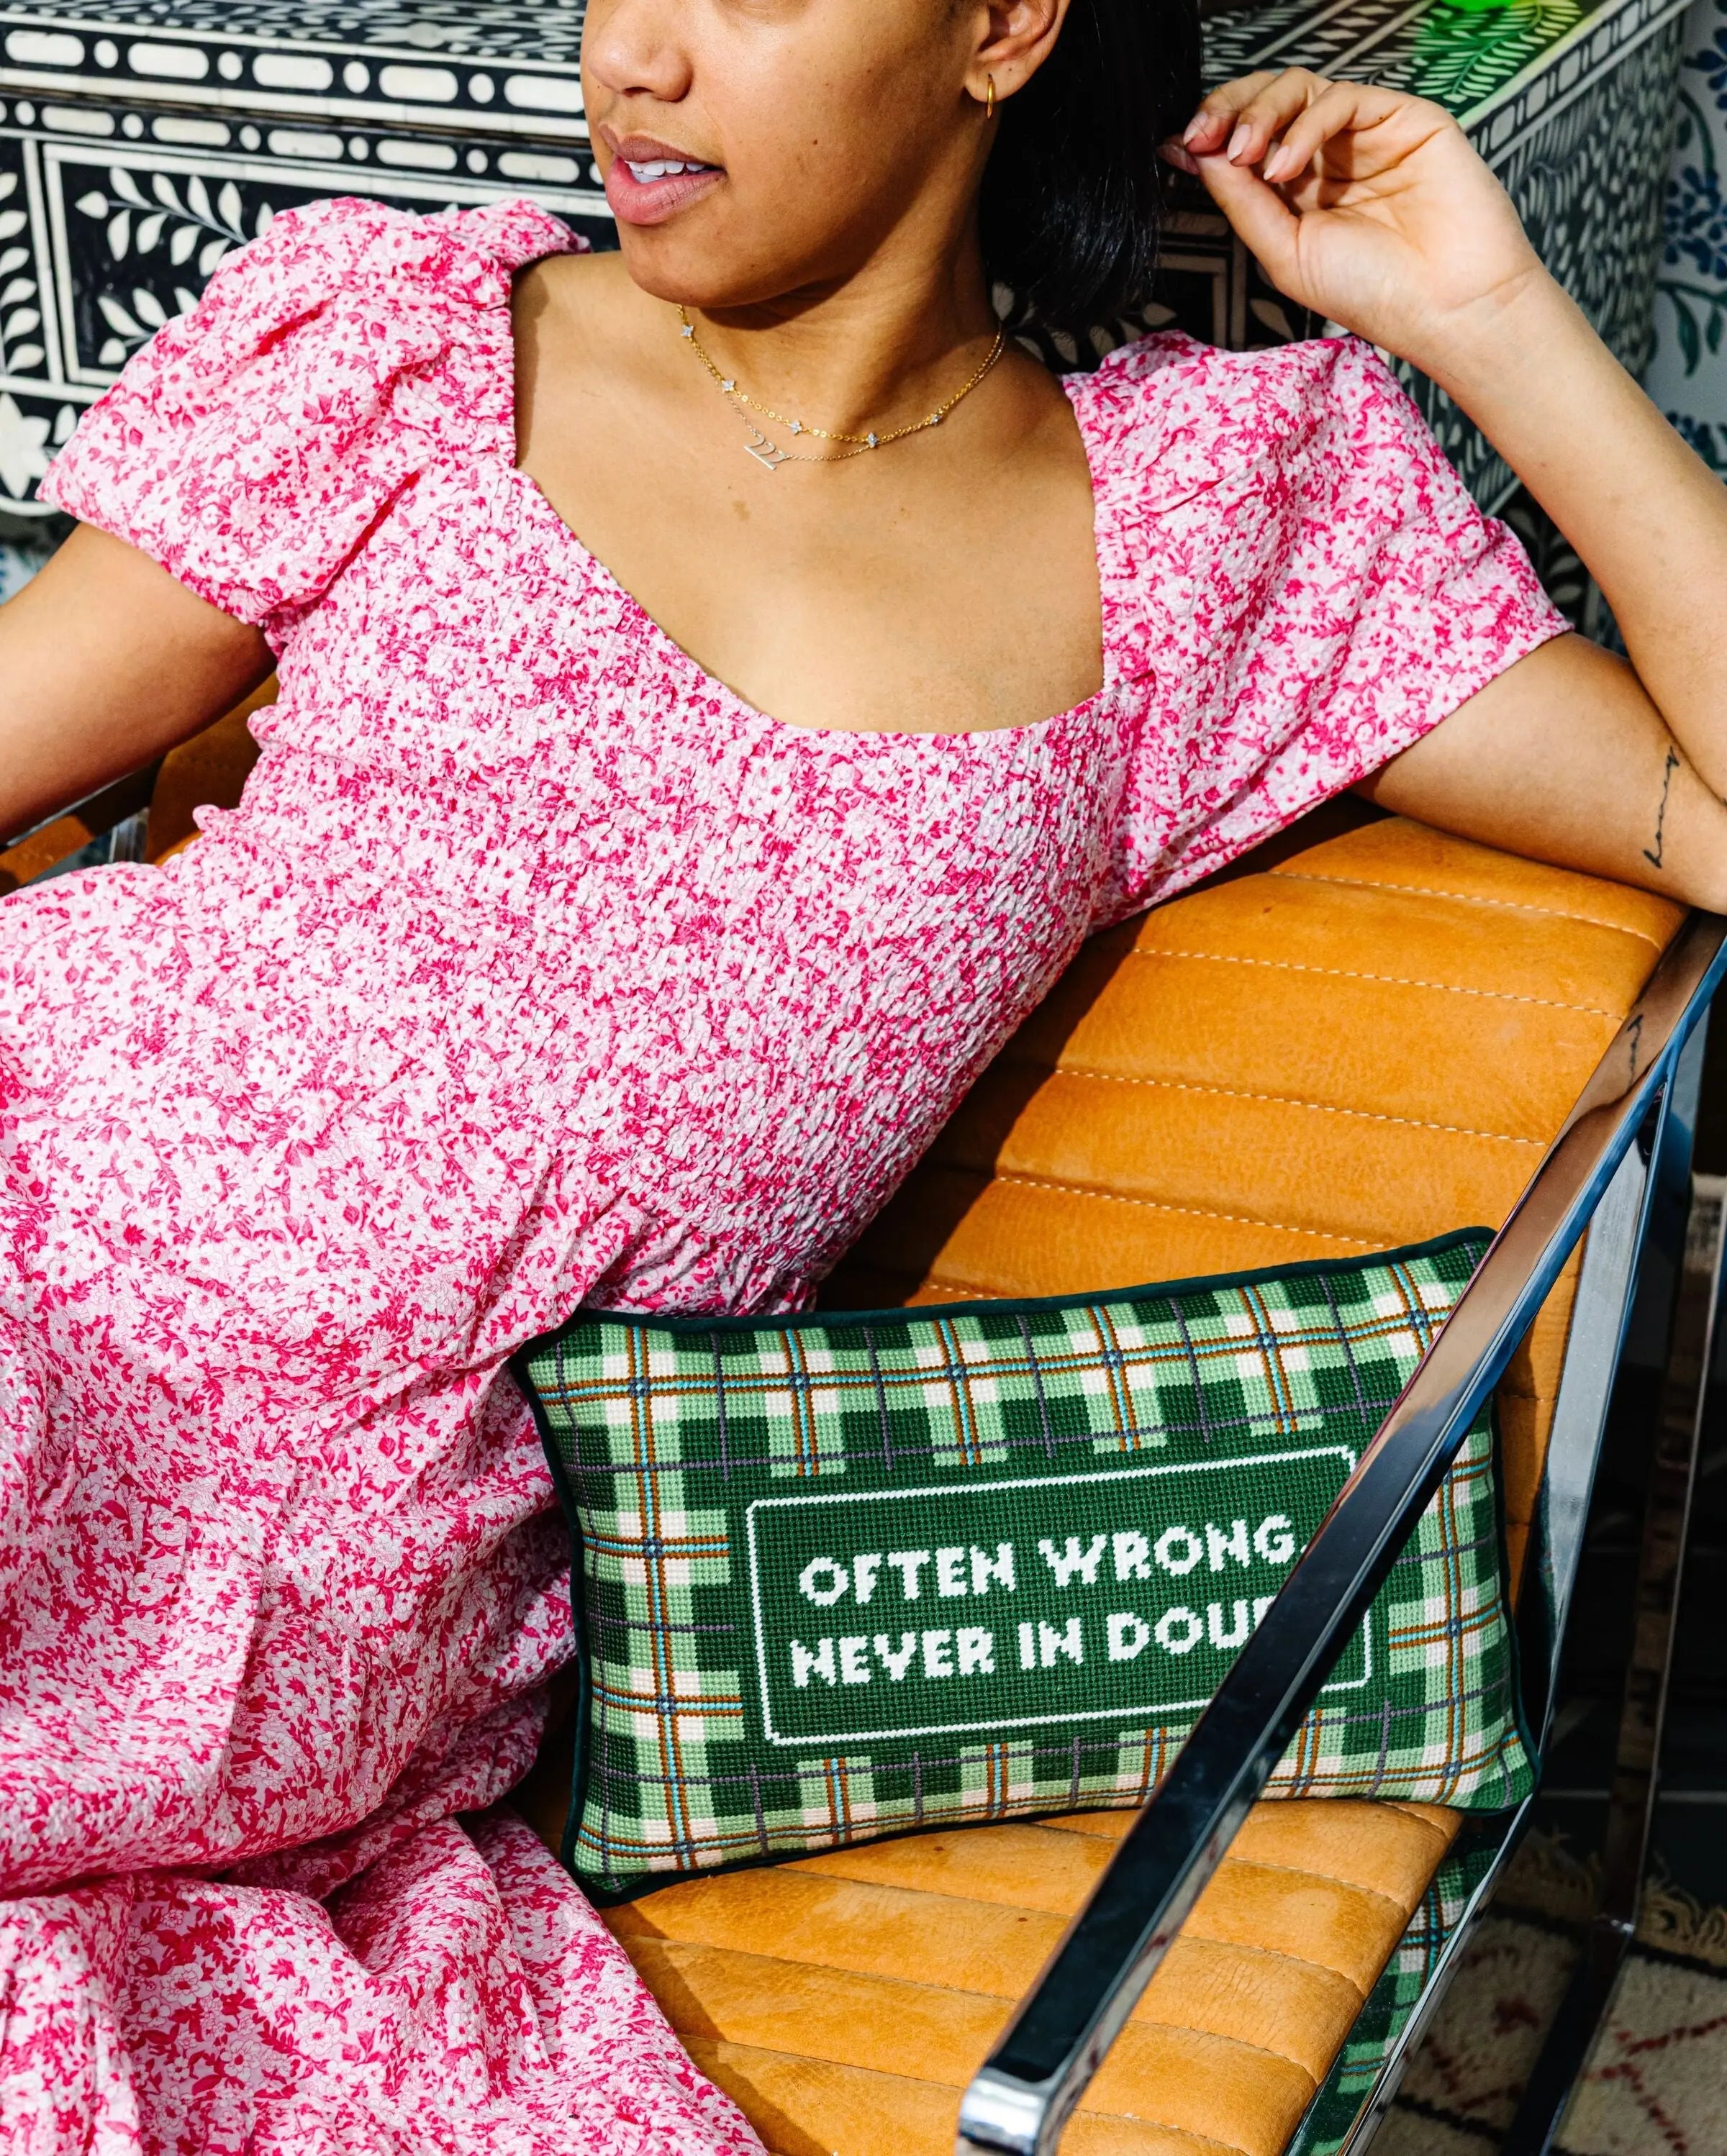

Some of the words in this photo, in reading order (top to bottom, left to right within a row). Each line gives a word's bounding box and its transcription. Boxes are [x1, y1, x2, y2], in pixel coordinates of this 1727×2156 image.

[798, 1542, 1017, 1607] OFTEN
[1037, 1514, 1307, 1588] WRONG
[789, 1625, 996, 1688] NEVER
[1017, 1616, 1084, 1670] IN
[1105, 1595, 1277, 1663] DOU
